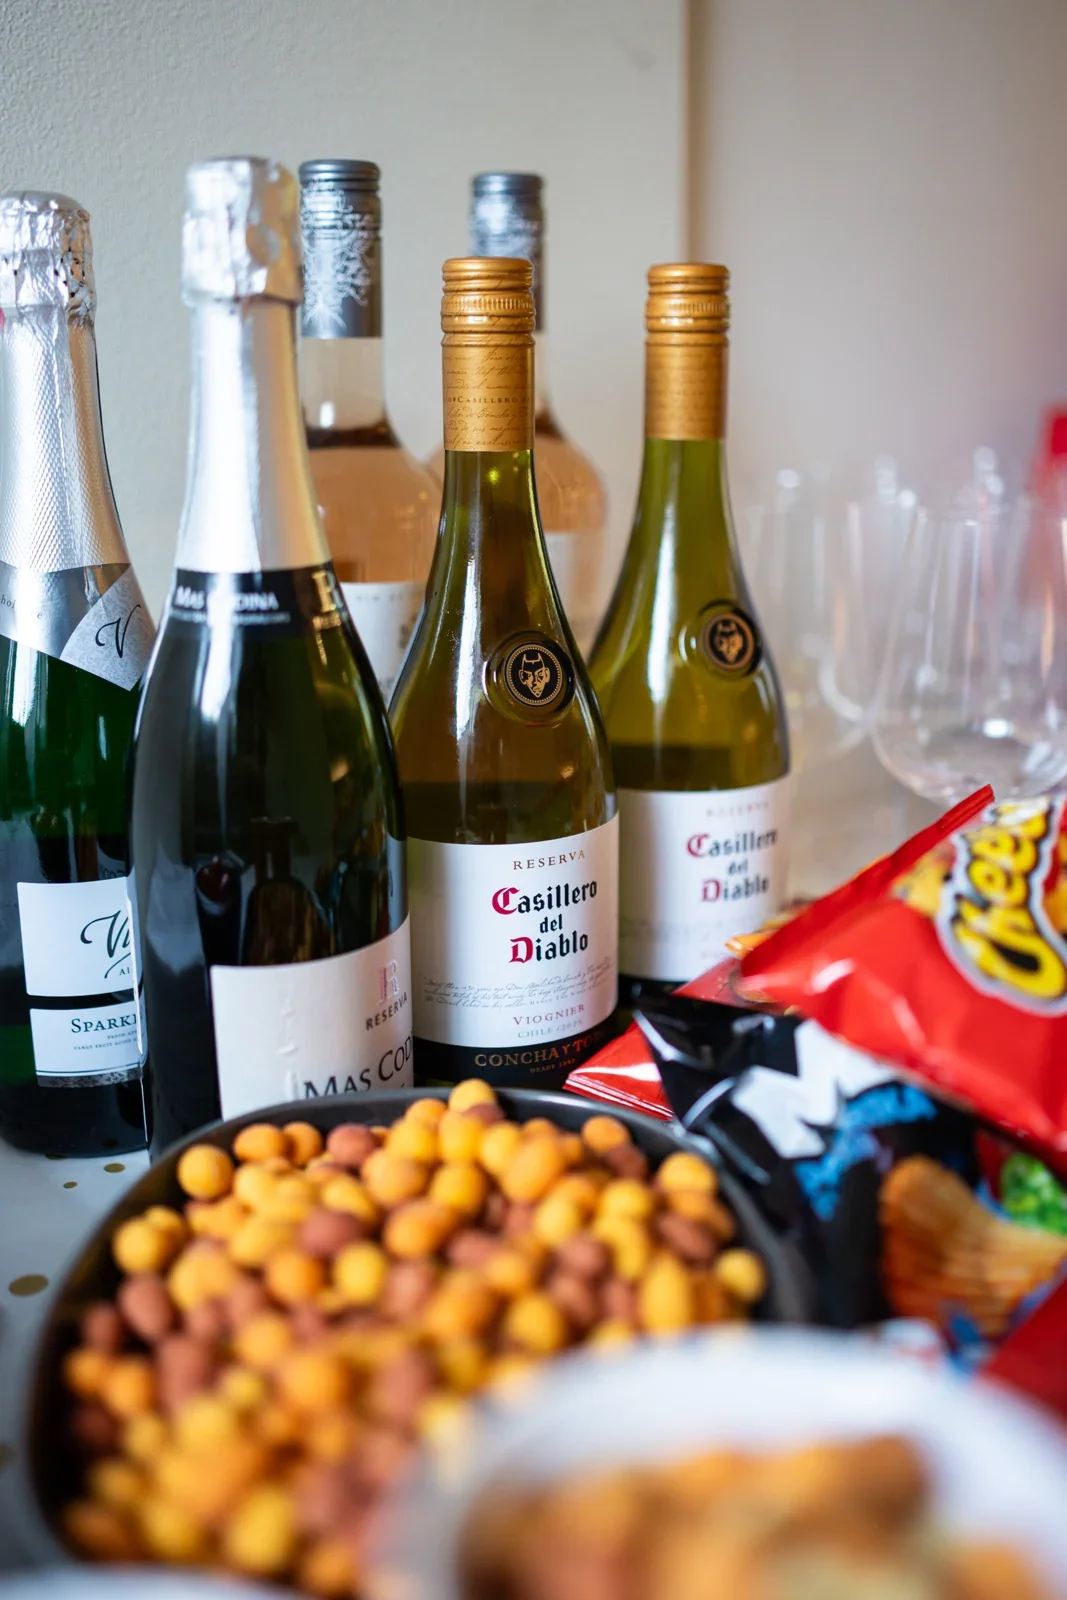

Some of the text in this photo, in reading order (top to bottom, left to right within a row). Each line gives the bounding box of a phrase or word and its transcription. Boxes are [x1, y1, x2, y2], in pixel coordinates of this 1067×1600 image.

[512, 850, 587, 871] RESERVA
[491, 880, 598, 915] Casillero
[539, 914, 564, 934] del
[509, 930, 589, 964] Diablo
[366, 991, 408, 1031] RESERVA
[512, 1003, 585, 1026] VIOGNIER
[517, 1026, 553, 1039] CHILE
[378, 1034, 412, 1082] COD
[474, 1046, 560, 1068] CONCHA
[562, 1043, 572, 1055] Y
